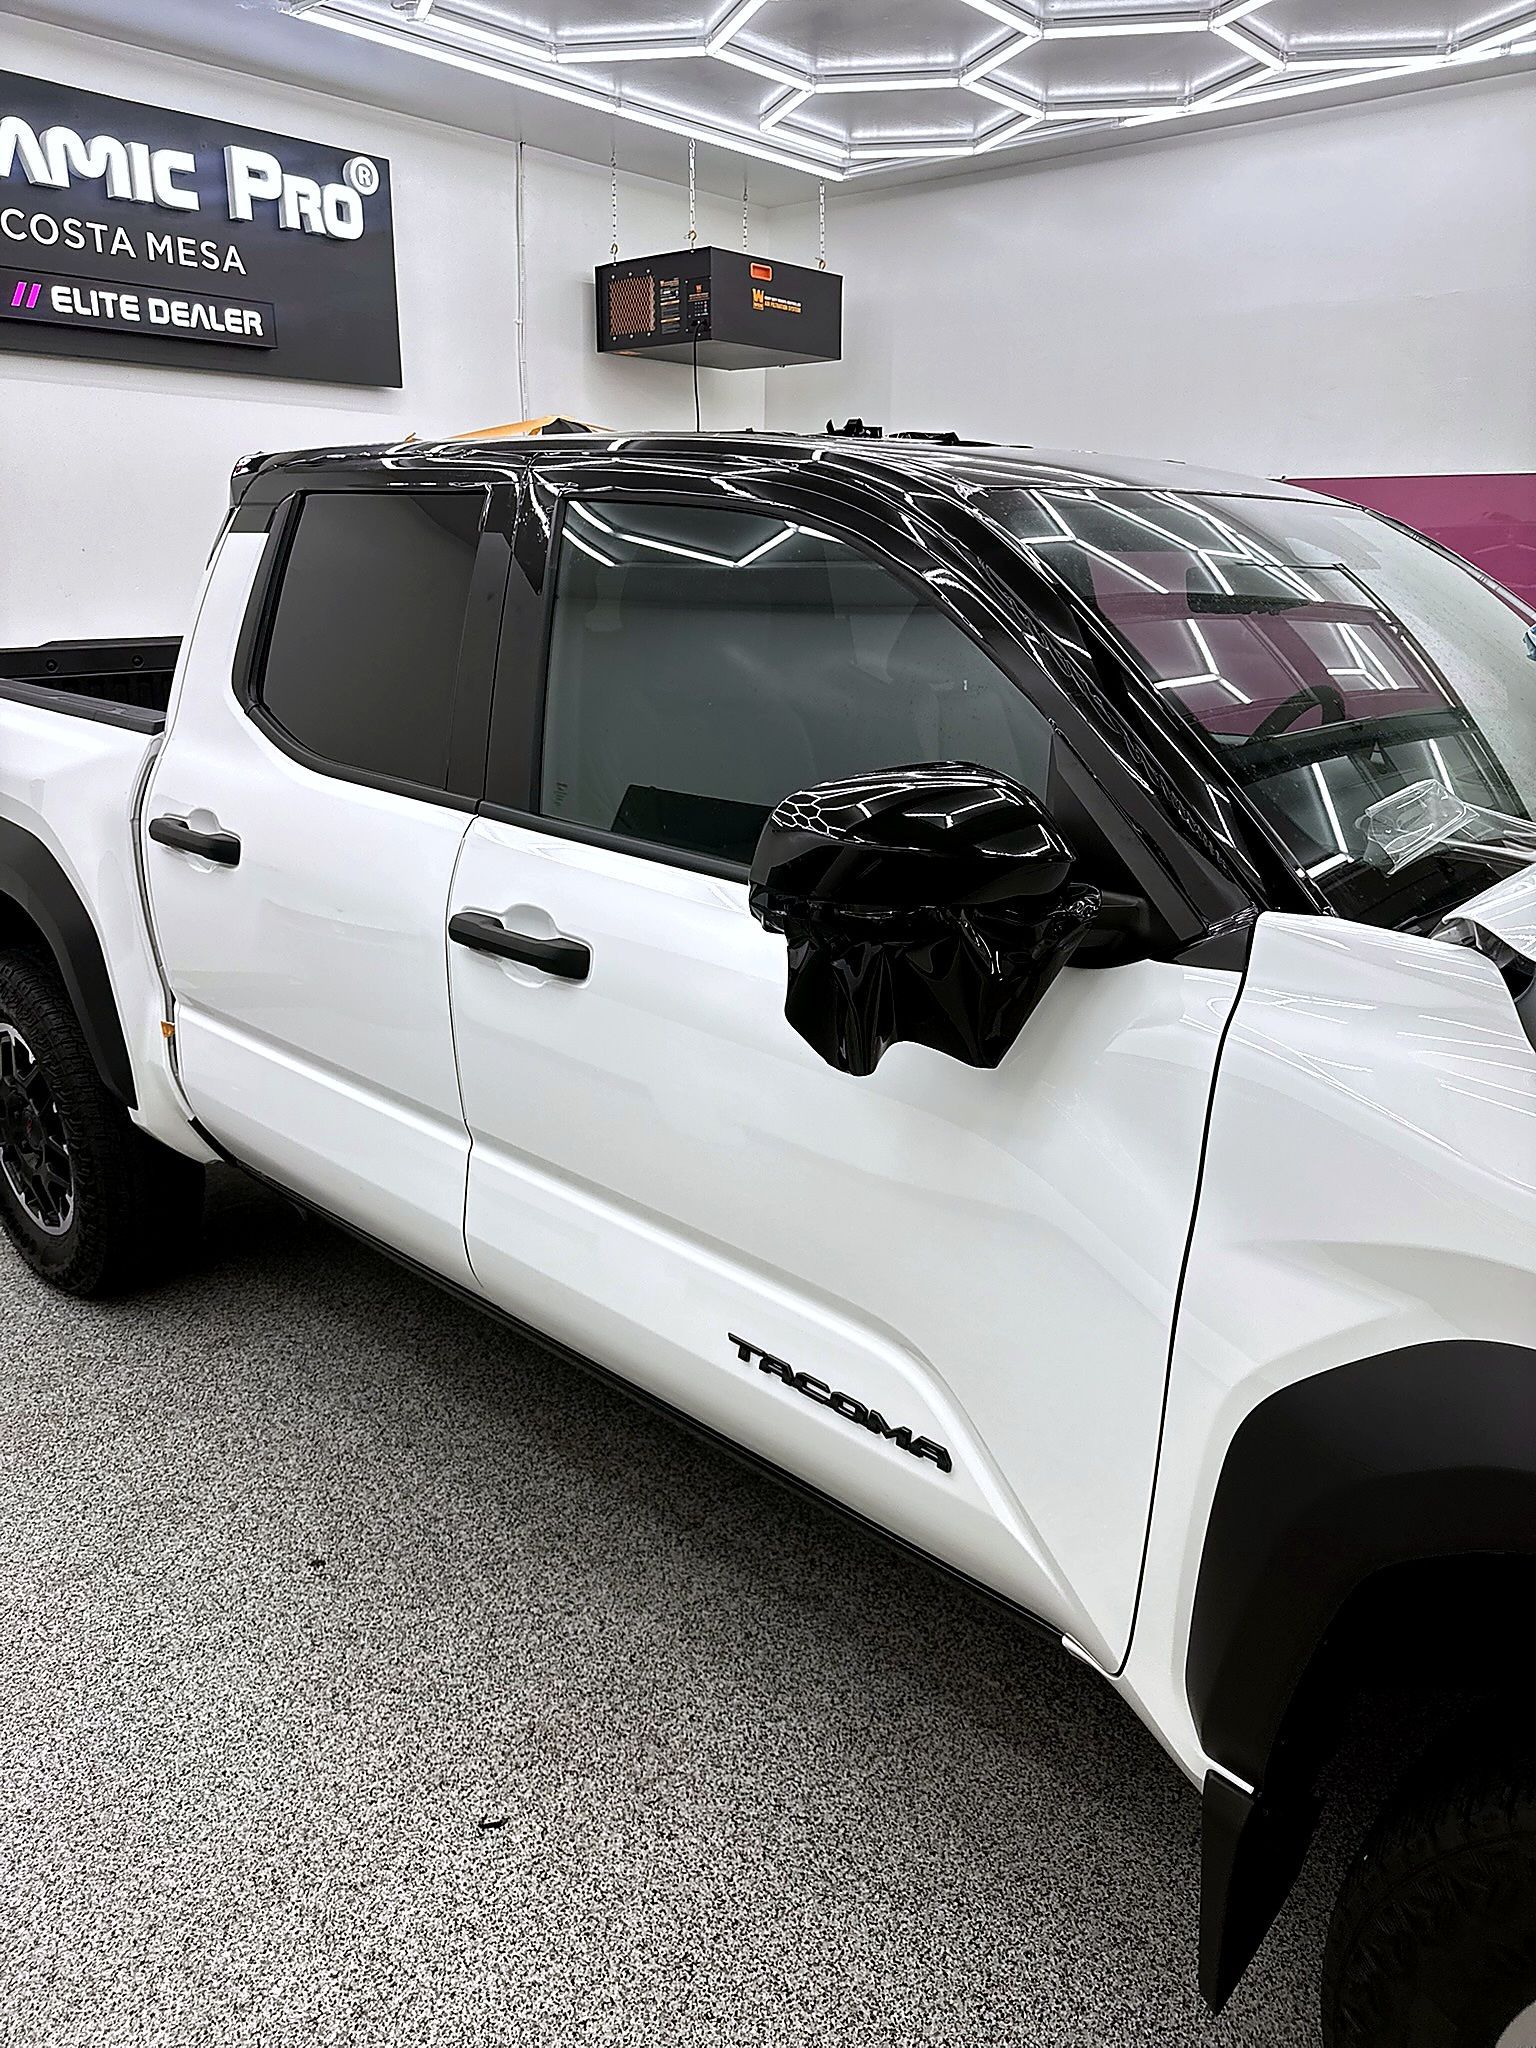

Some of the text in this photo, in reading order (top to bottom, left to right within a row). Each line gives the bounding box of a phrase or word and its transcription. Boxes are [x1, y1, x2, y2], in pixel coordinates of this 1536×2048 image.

[0, 207, 247, 276] COSTA MESA
[50, 284, 264, 337] ELITE DEALER
[727, 1332, 952, 1474] TACOMA
